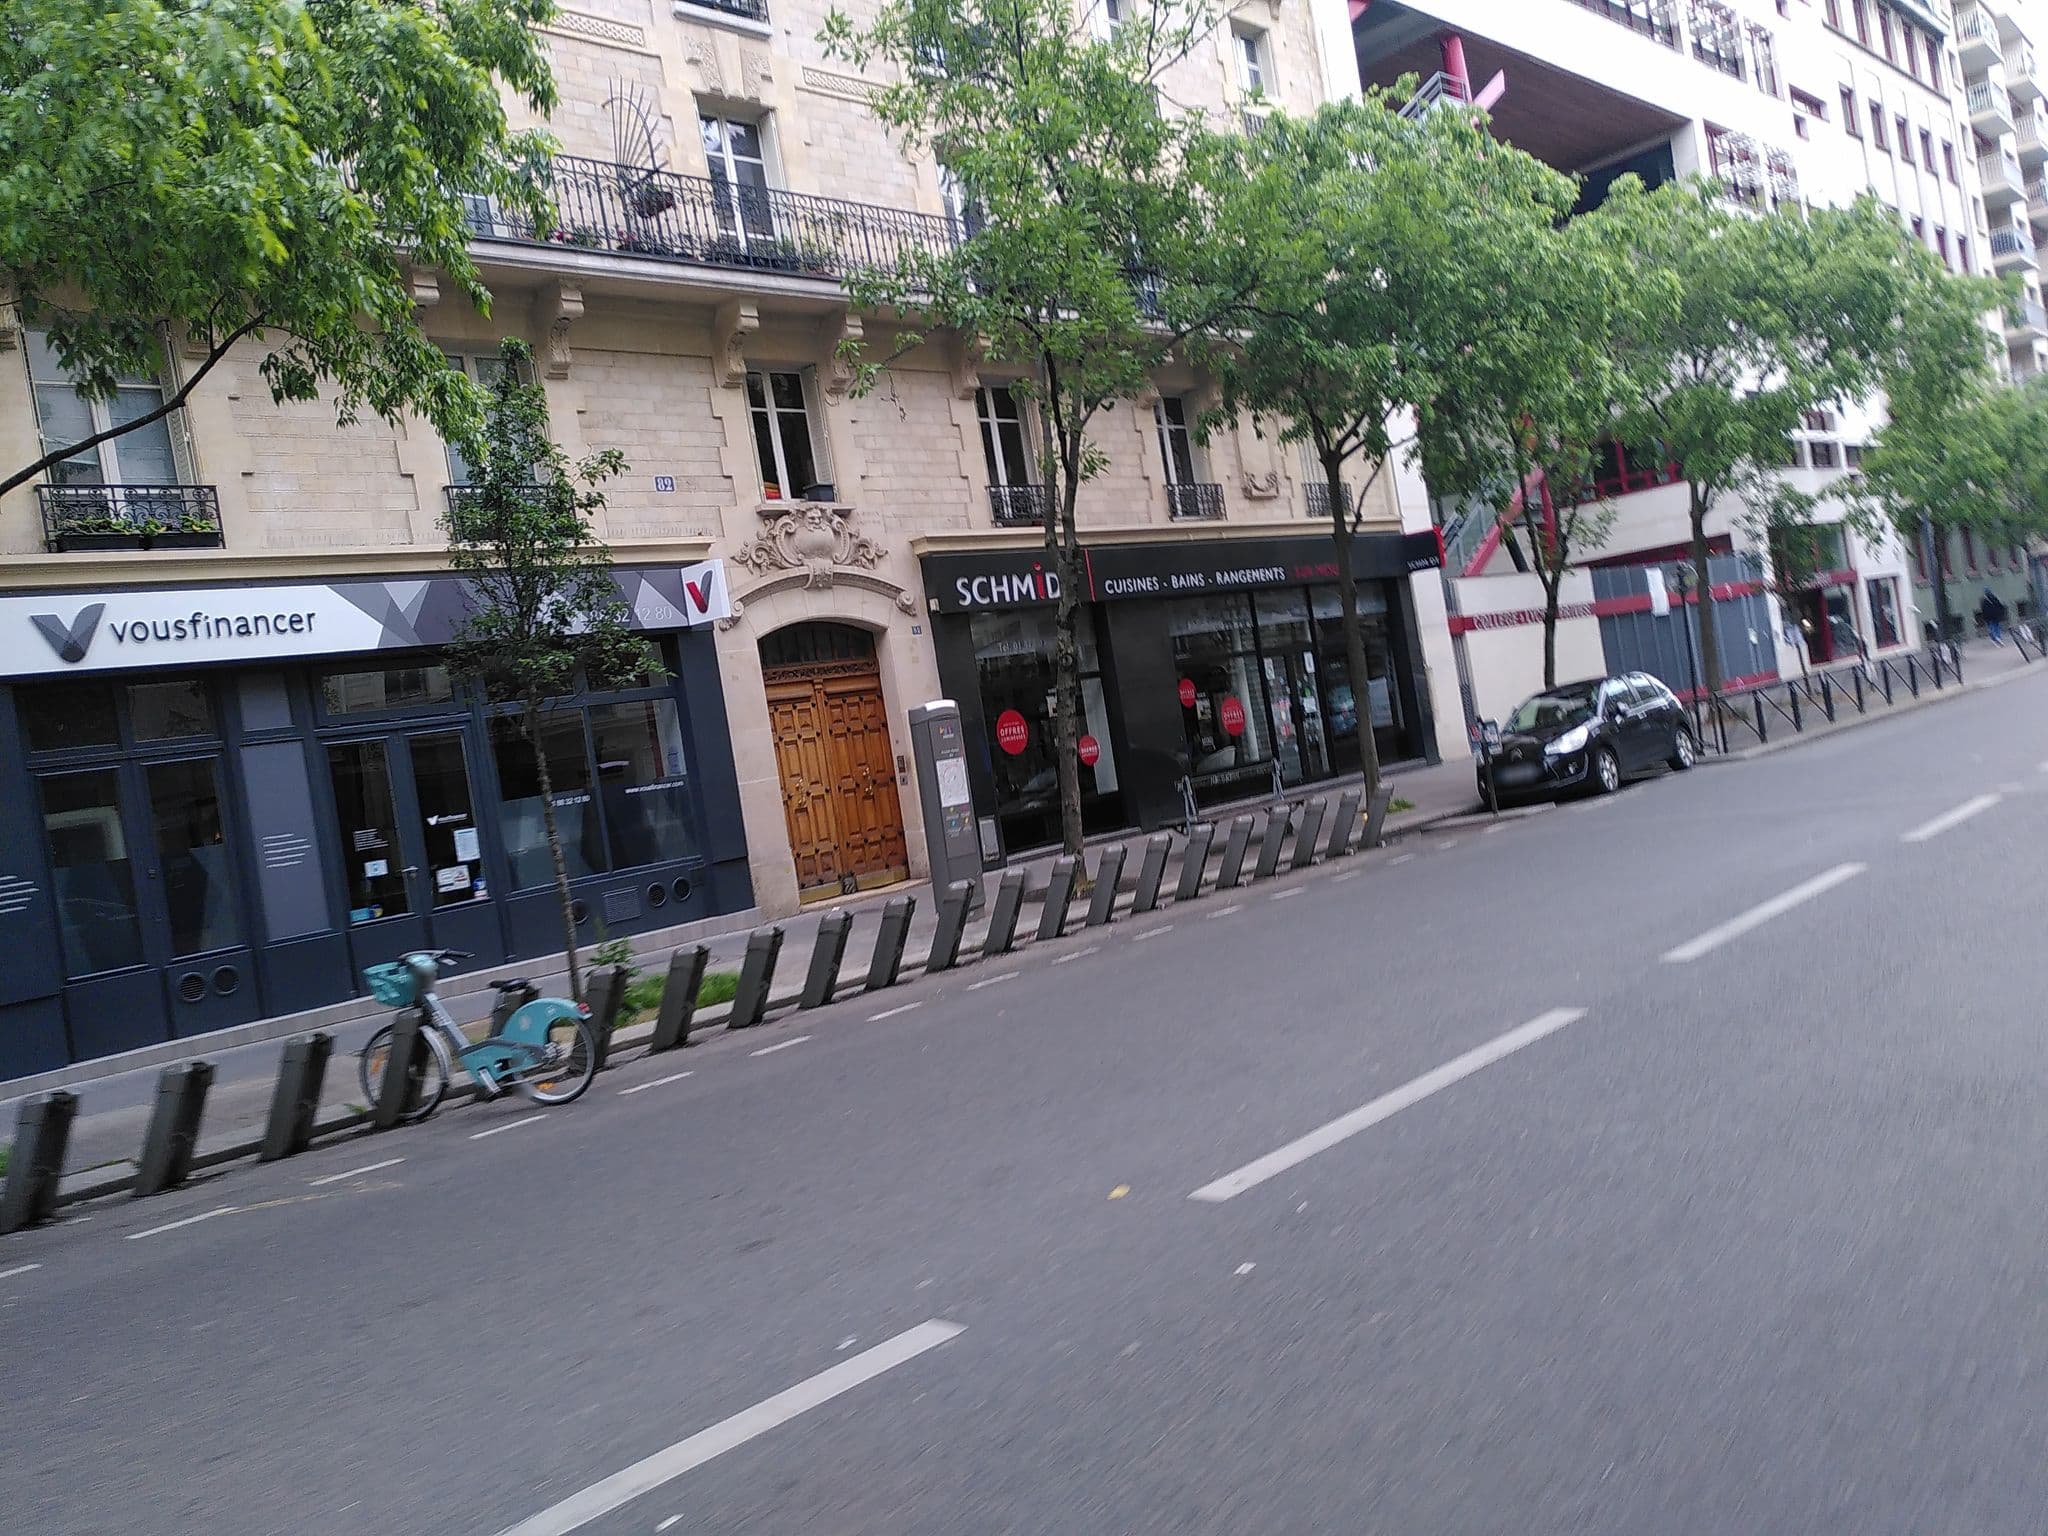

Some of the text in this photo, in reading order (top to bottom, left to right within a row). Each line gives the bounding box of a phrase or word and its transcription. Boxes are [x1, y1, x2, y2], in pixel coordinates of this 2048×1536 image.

[657, 477, 673, 491] 82
[1104, 566, 1287, 595] CUISINES BAINS RANGEMENTS
[655, 605, 673, 620] 80
[110, 610, 316, 644] vousfinancer
[1000, 725, 1025, 737] OFFRES
